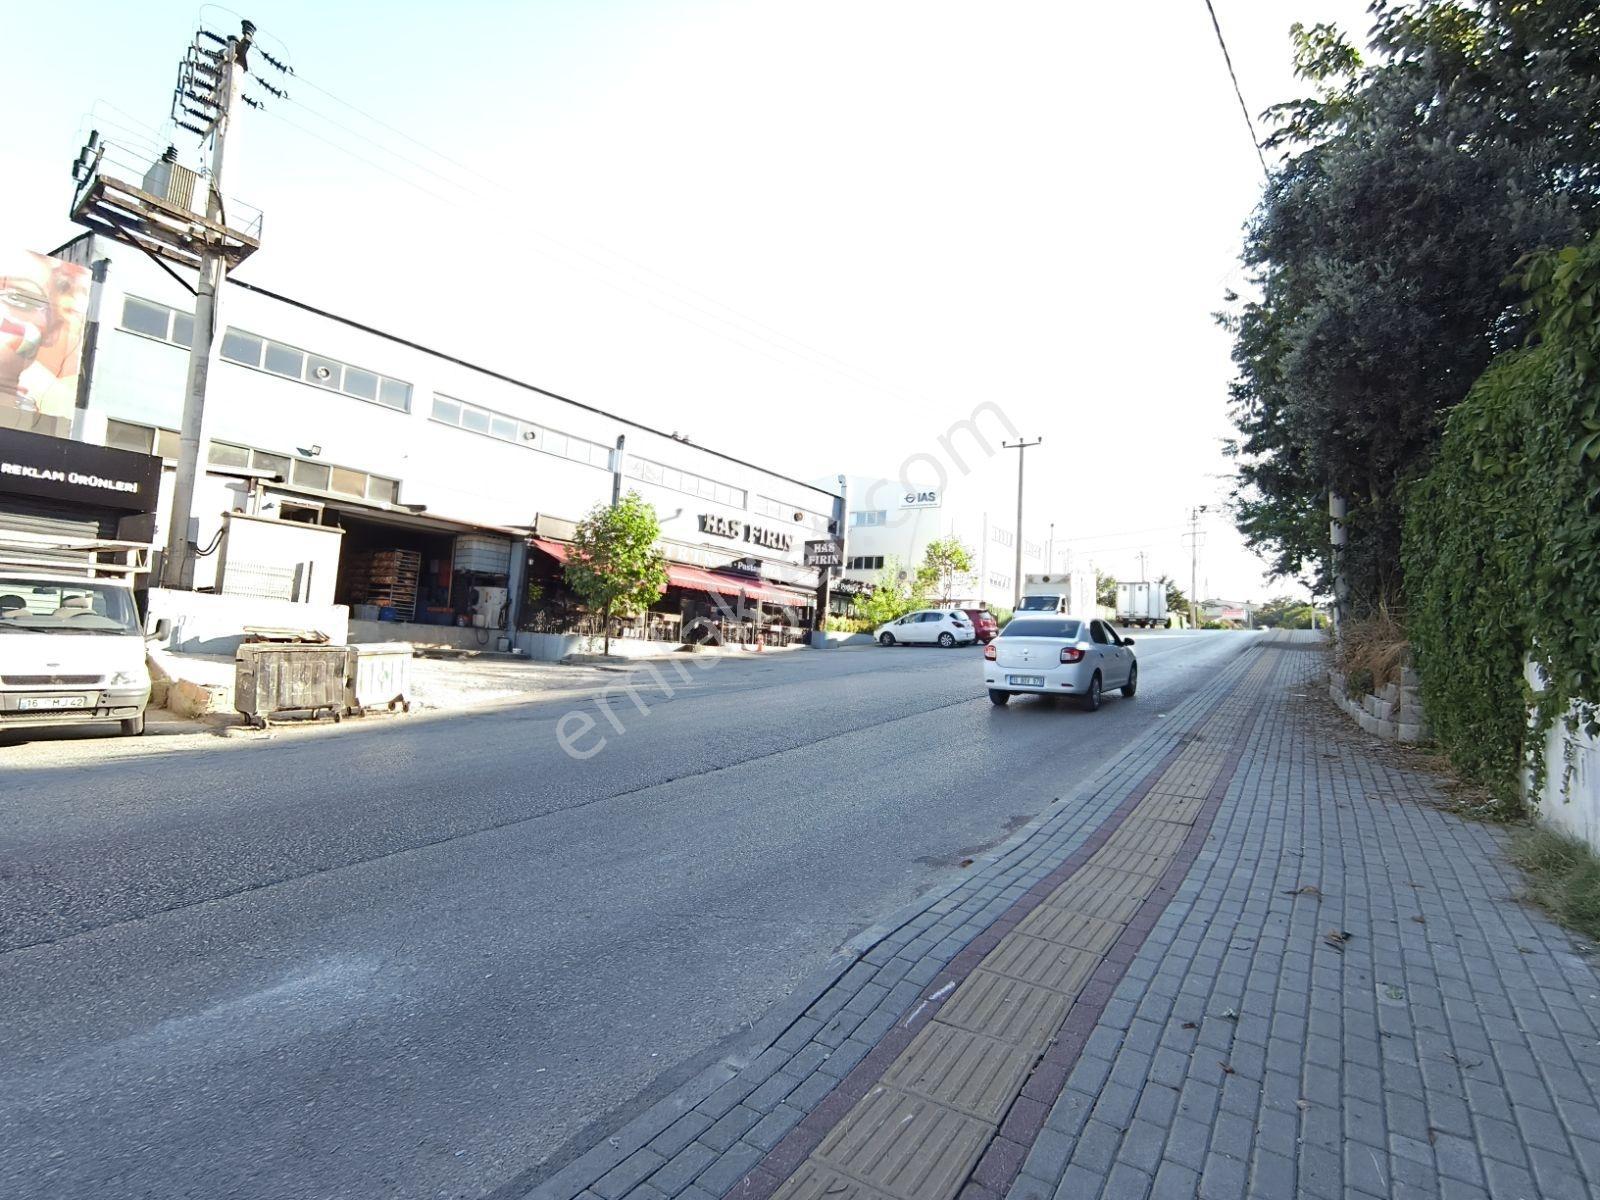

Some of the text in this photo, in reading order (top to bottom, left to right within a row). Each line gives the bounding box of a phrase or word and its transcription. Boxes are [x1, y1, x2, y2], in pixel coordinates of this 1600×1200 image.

[1, 463, 65, 482] REKLAM
[917, 492, 936, 503] IAS
[699, 513, 793, 552] HAS FIRIN
[814, 543, 835, 553] HAS
[808, 555, 839, 565] FIRIN
